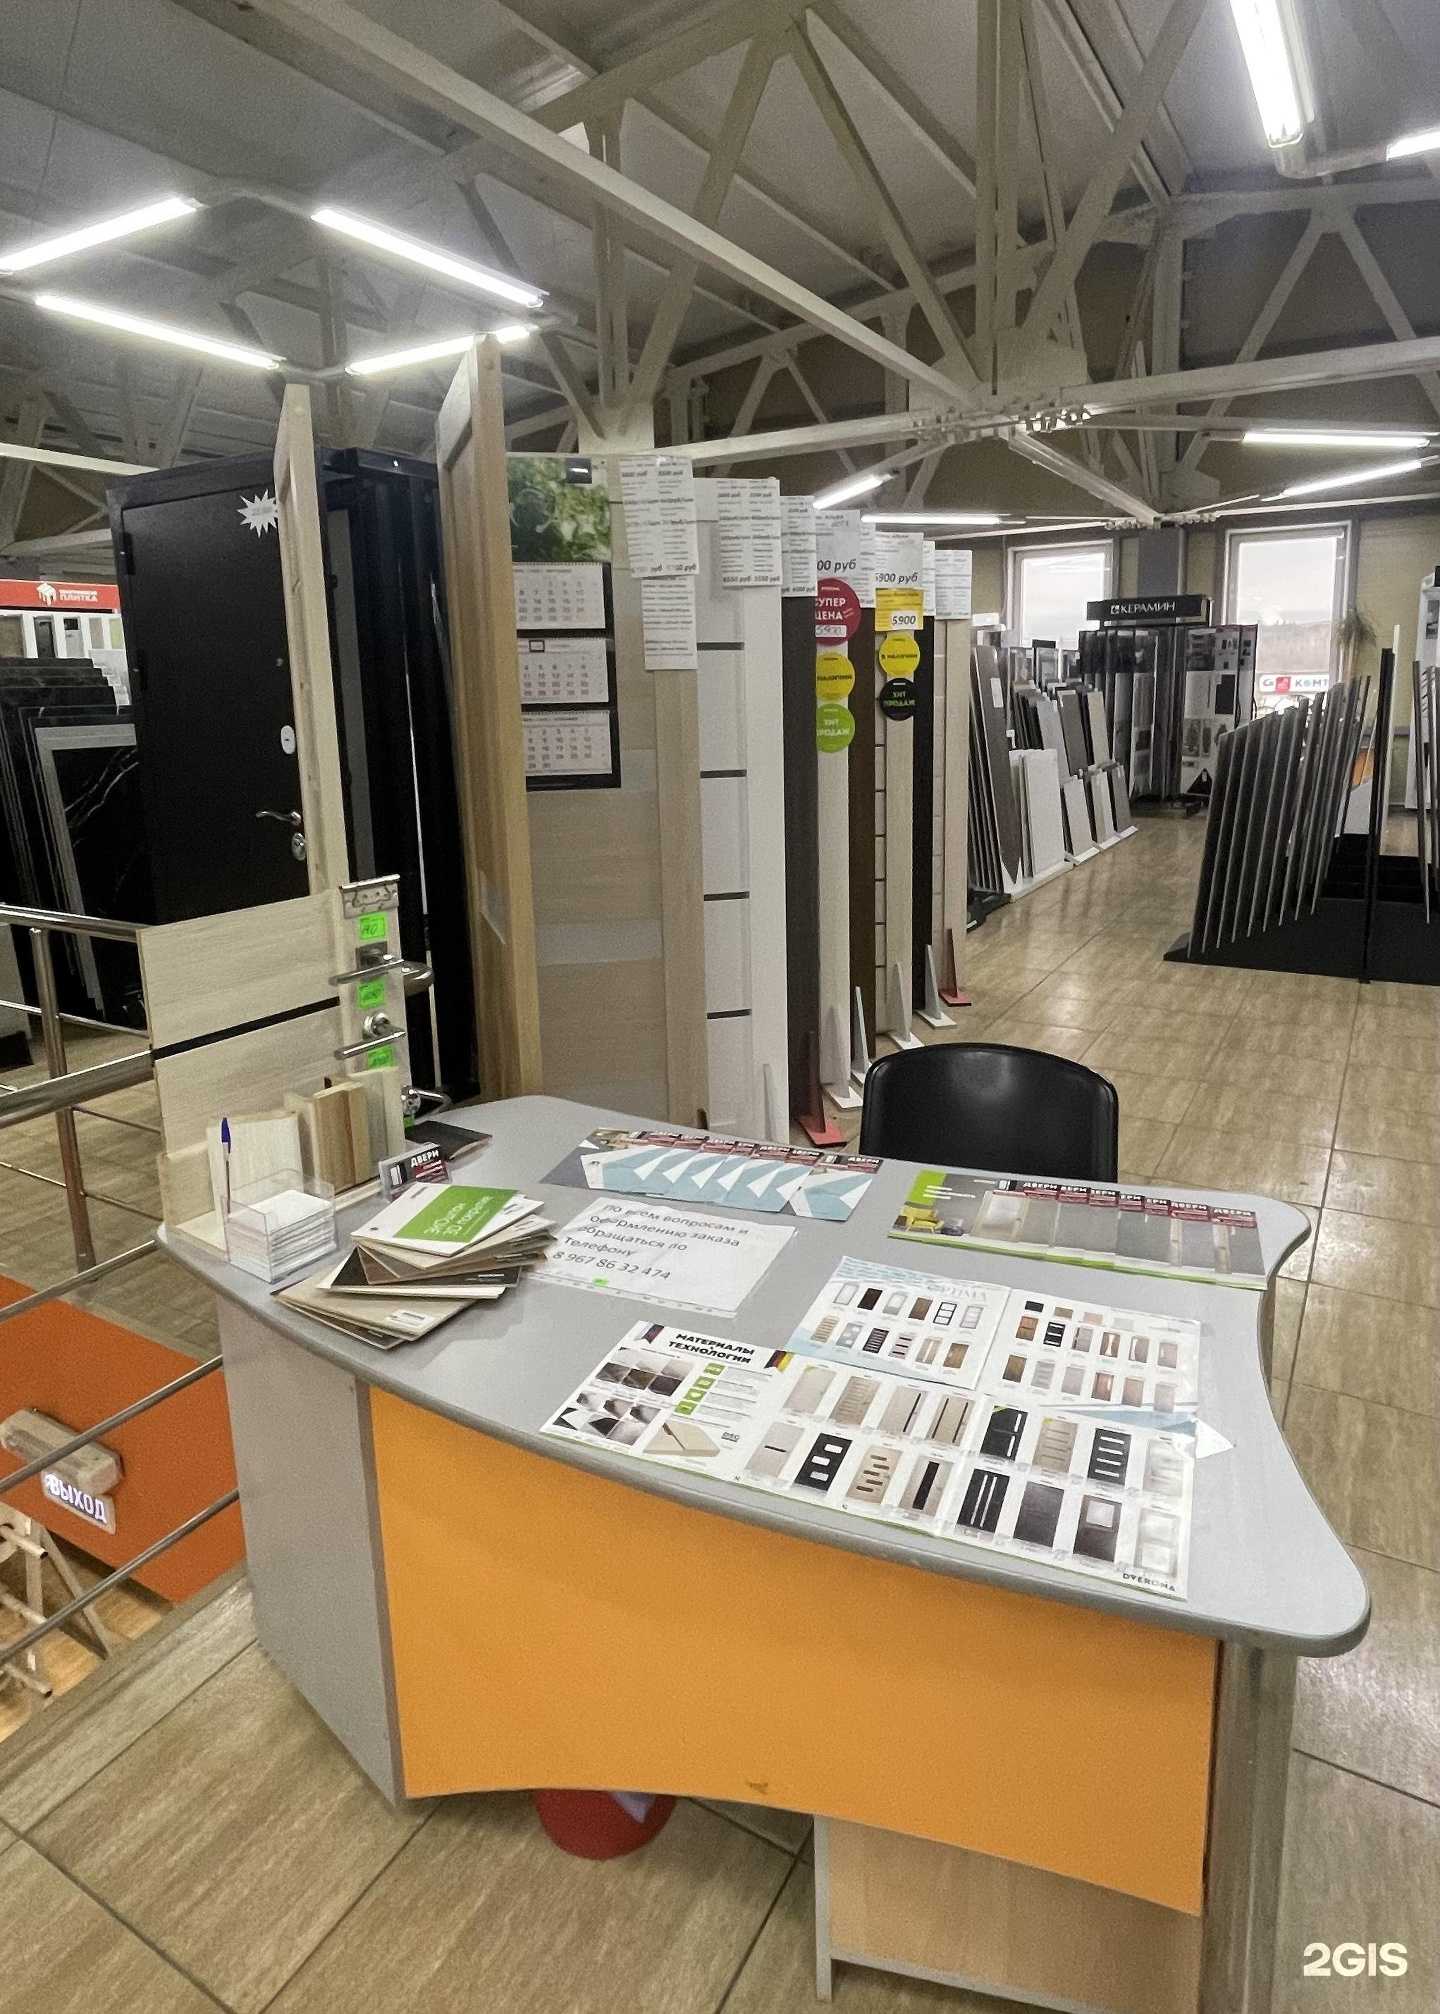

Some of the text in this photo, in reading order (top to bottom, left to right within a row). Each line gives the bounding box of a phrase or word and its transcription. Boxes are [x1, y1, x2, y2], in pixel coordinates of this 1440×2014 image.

[817, 558, 857, 573] 00 руб
[898, 572, 919, 585] руб
[1120, 602, 1176, 613] КЕРАМИН
[892, 615, 916, 625] 5900
[410, 1150, 439, 1168] ДВЕРИ
[690, 1232, 740, 1246] заказа
[553, 1251, 670, 1279] 8 967 86 32 474
[668, 1340, 752, 1364] ТЕХНОЛОГИИ
[676, 1333, 756, 1355] МАТЕРИАЛЫ
[49, 1475, 108, 1524] ВЫХОД
